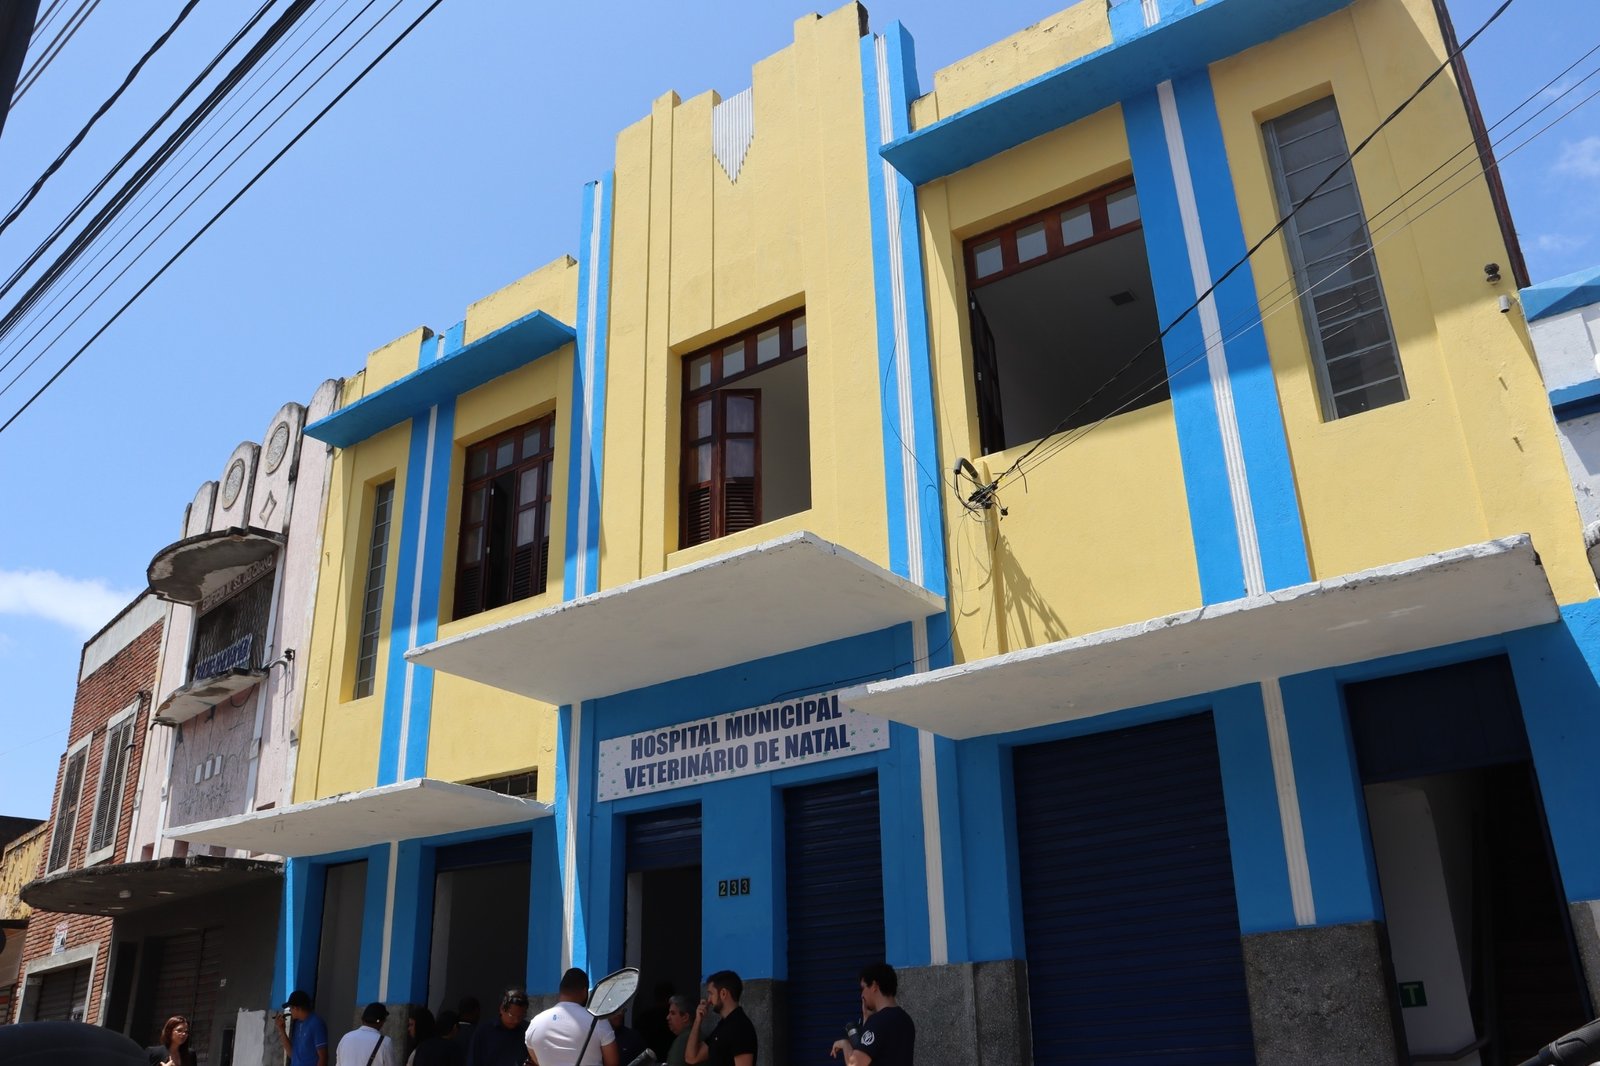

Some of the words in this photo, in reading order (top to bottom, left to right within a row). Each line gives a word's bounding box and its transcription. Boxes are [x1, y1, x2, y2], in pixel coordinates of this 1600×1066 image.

[624, 745, 749, 789] VETERINÁRIO
[754, 738, 780, 765] DE
[785, 724, 850, 760] NATAL
[631, 721, 720, 760] HOSPITAL
[725, 694, 842, 741] MUNICIPAL
[719, 880, 749, 896] 233
